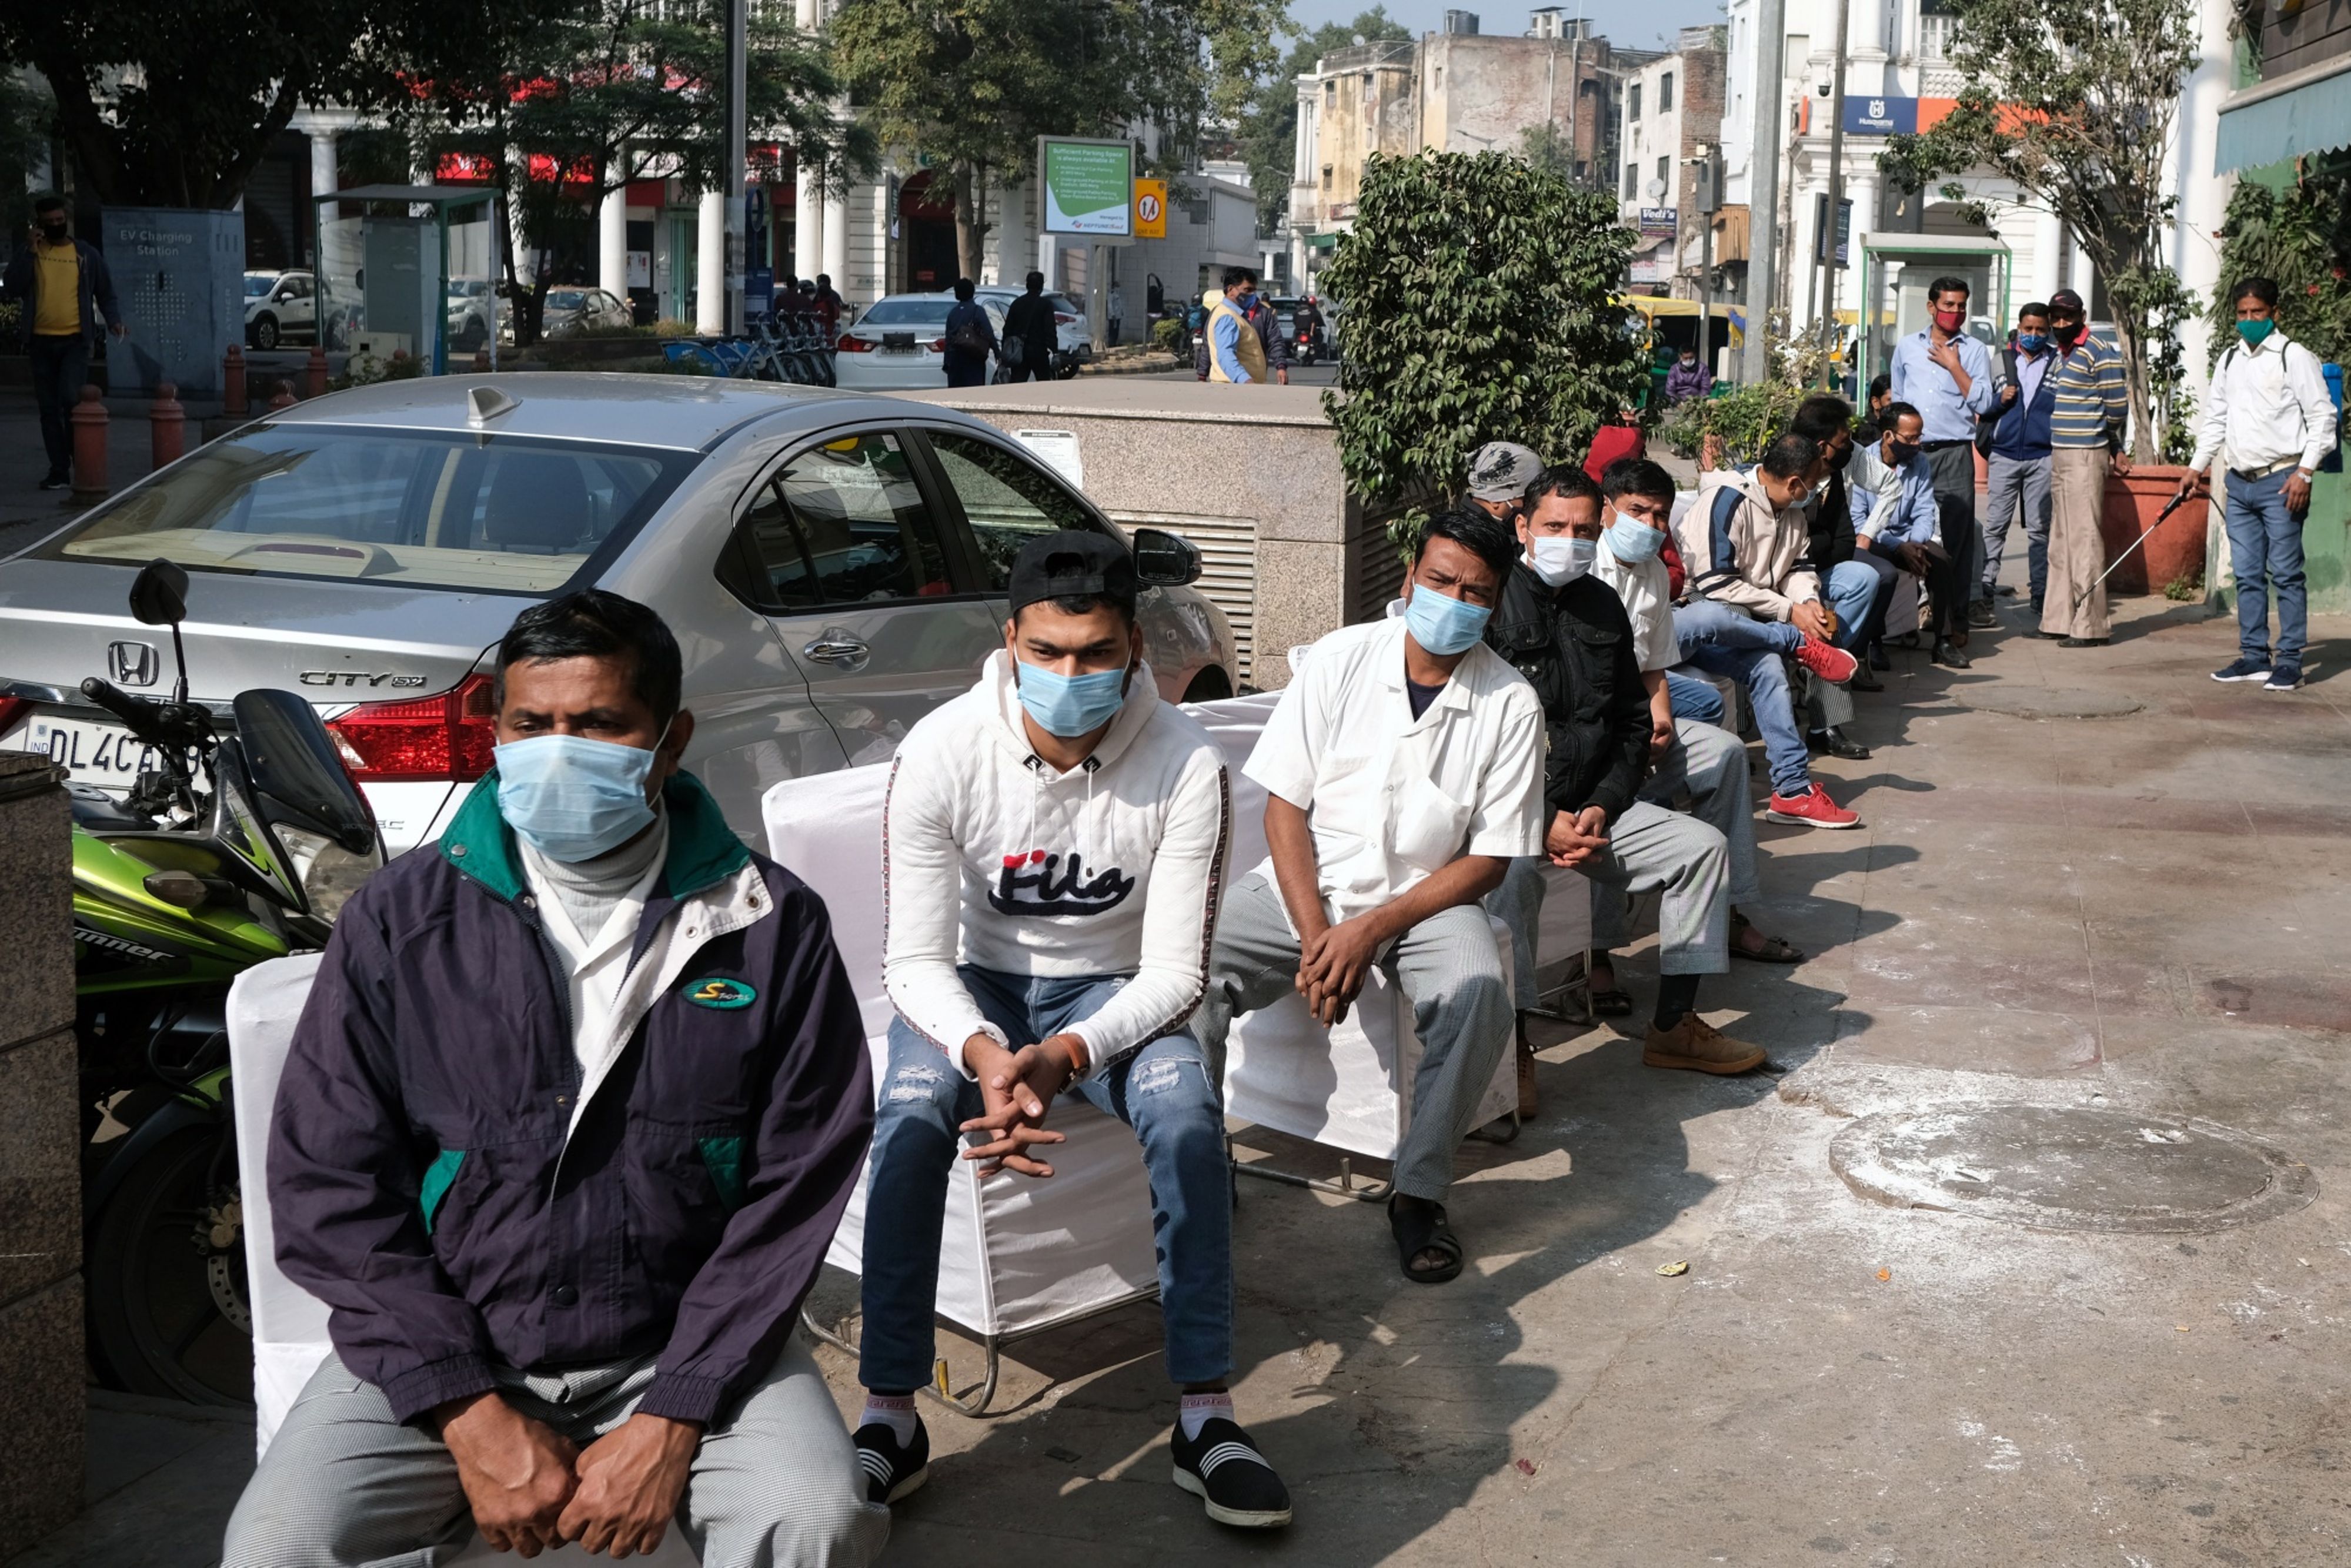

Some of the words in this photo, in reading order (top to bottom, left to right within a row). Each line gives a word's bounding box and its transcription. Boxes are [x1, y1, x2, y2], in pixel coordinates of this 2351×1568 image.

[1858, 118, 1894, 126] Husqvarna
[1642, 209, 1675, 219] Vedi's
[121, 230, 136, 240] EV
[139, 231, 193, 245] Charging
[137, 245, 179, 256] Station
[299, 670, 392, 687] CITY
[31, 742, 48, 753] IND
[49, 729, 202, 777] DL4CA9
